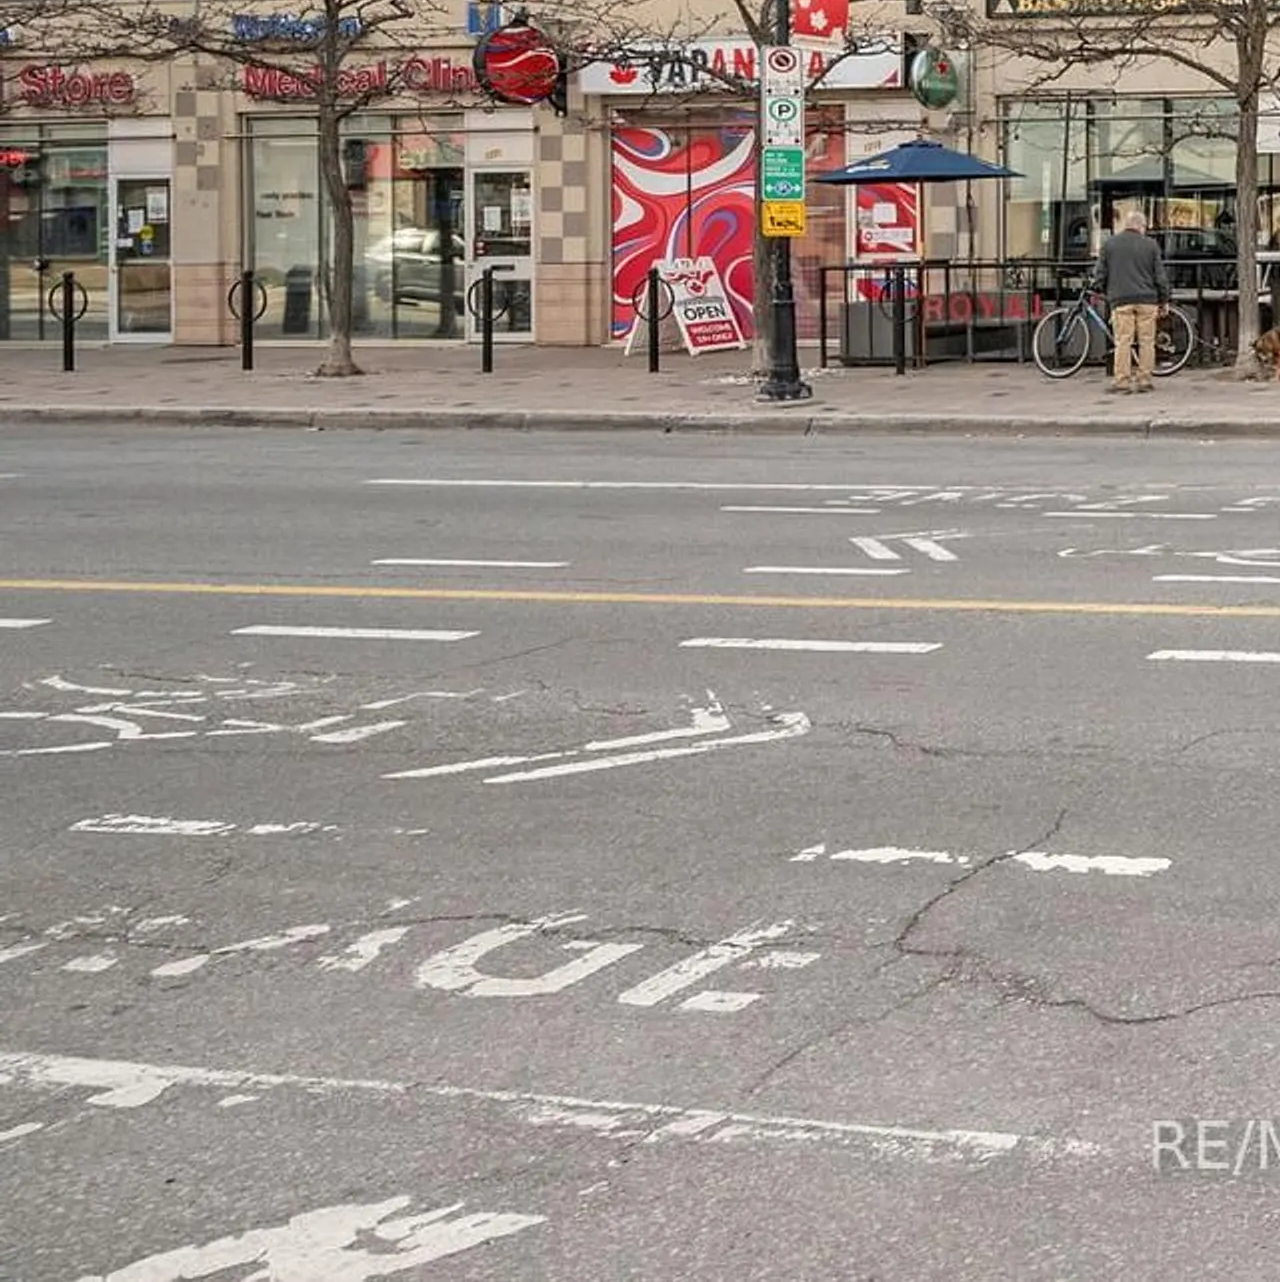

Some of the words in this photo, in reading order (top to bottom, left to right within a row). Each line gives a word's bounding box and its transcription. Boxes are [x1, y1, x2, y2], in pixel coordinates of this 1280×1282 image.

[18, 64, 136, 106] Store
[243, 62, 387, 98] Medcal
[684, 305, 726, 321] OPEN
